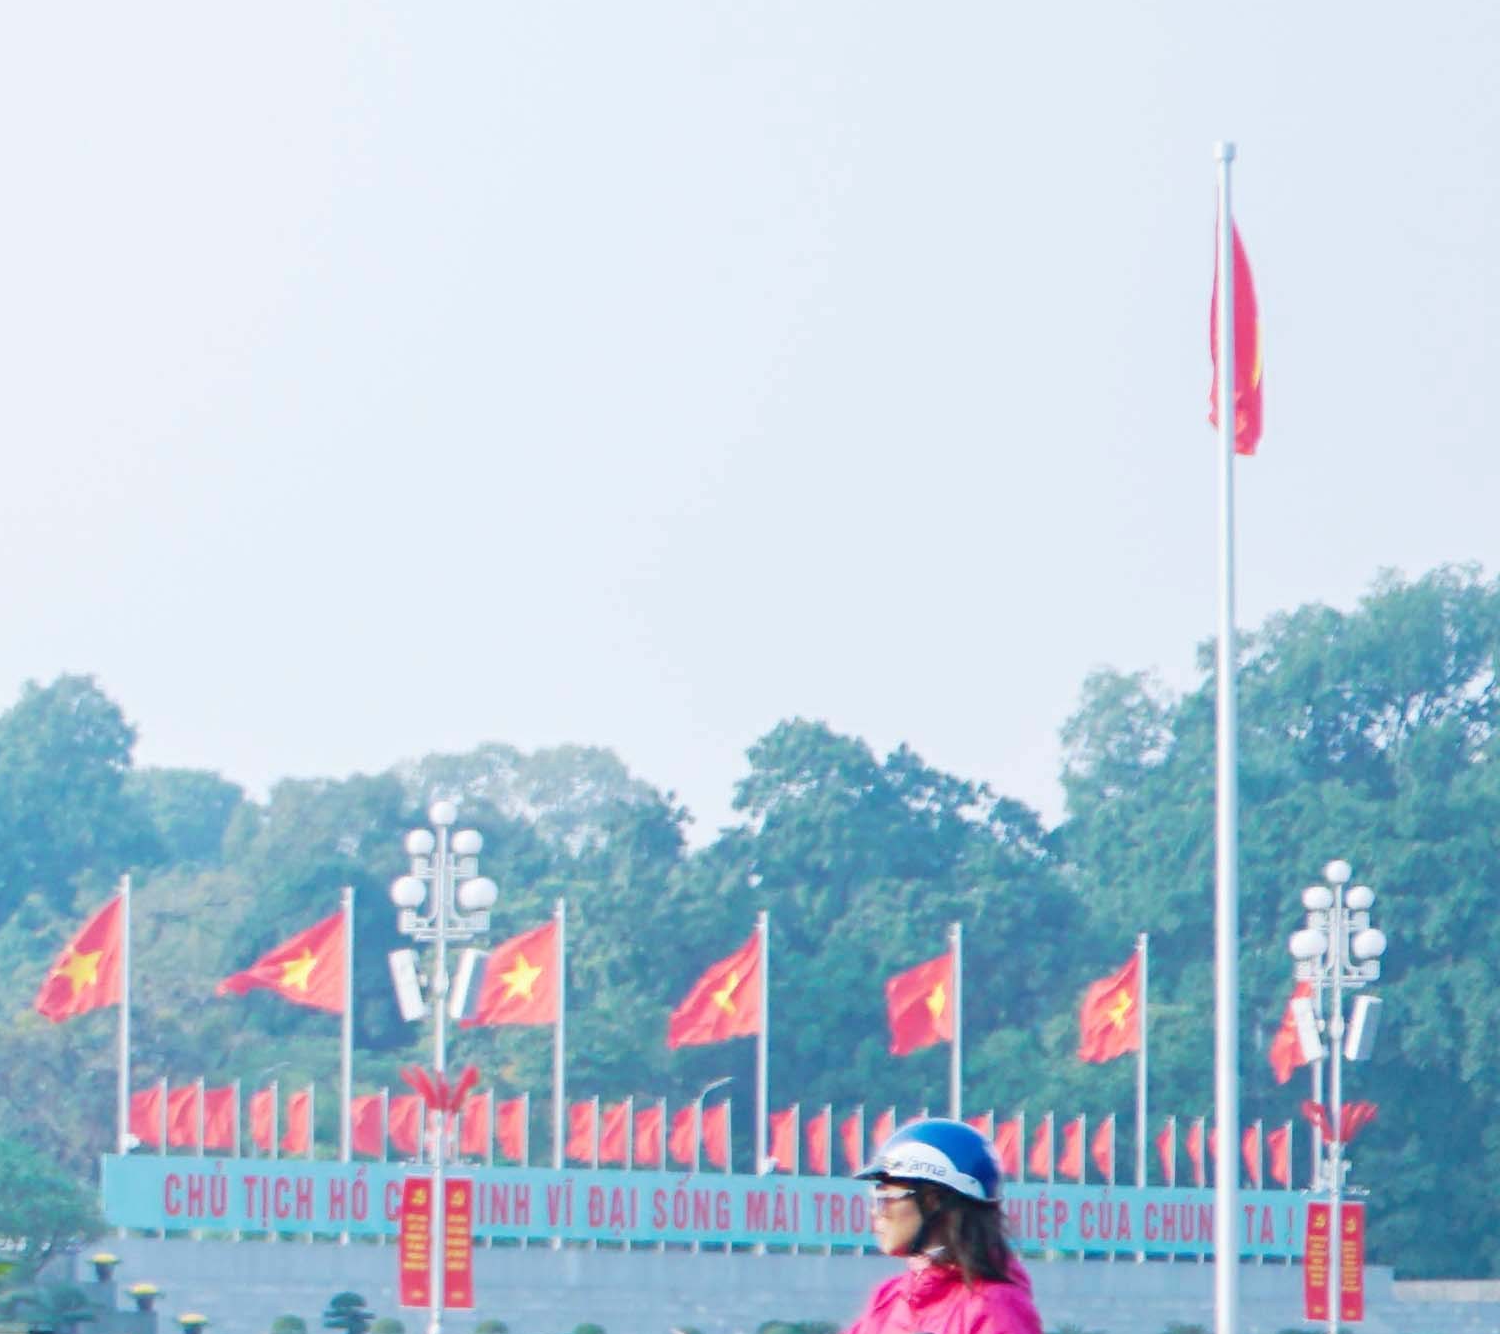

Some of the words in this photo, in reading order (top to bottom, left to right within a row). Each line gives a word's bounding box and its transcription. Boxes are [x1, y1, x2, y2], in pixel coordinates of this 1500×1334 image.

[164, 1161, 228, 1218] CHỦ
[243, 1176, 314, 1227] TỊCH
[479, 1173, 531, 1226] INH
[547, 1169, 574, 1227] VĨ
[588, 1185, 638, 1235] ĐẠI
[652, 1174, 731, 1230] SỐNG
[745, 1184, 799, 1232] MÃI
[814, 1192, 877, 1234] TRO
[1007, 1190, 1069, 1246] HIỆP
[1081, 1187, 1132, 1242] CỦA
[1144, 1194, 1214, 1244] CHÚN
[1244, 1204, 1275, 1244] TA
